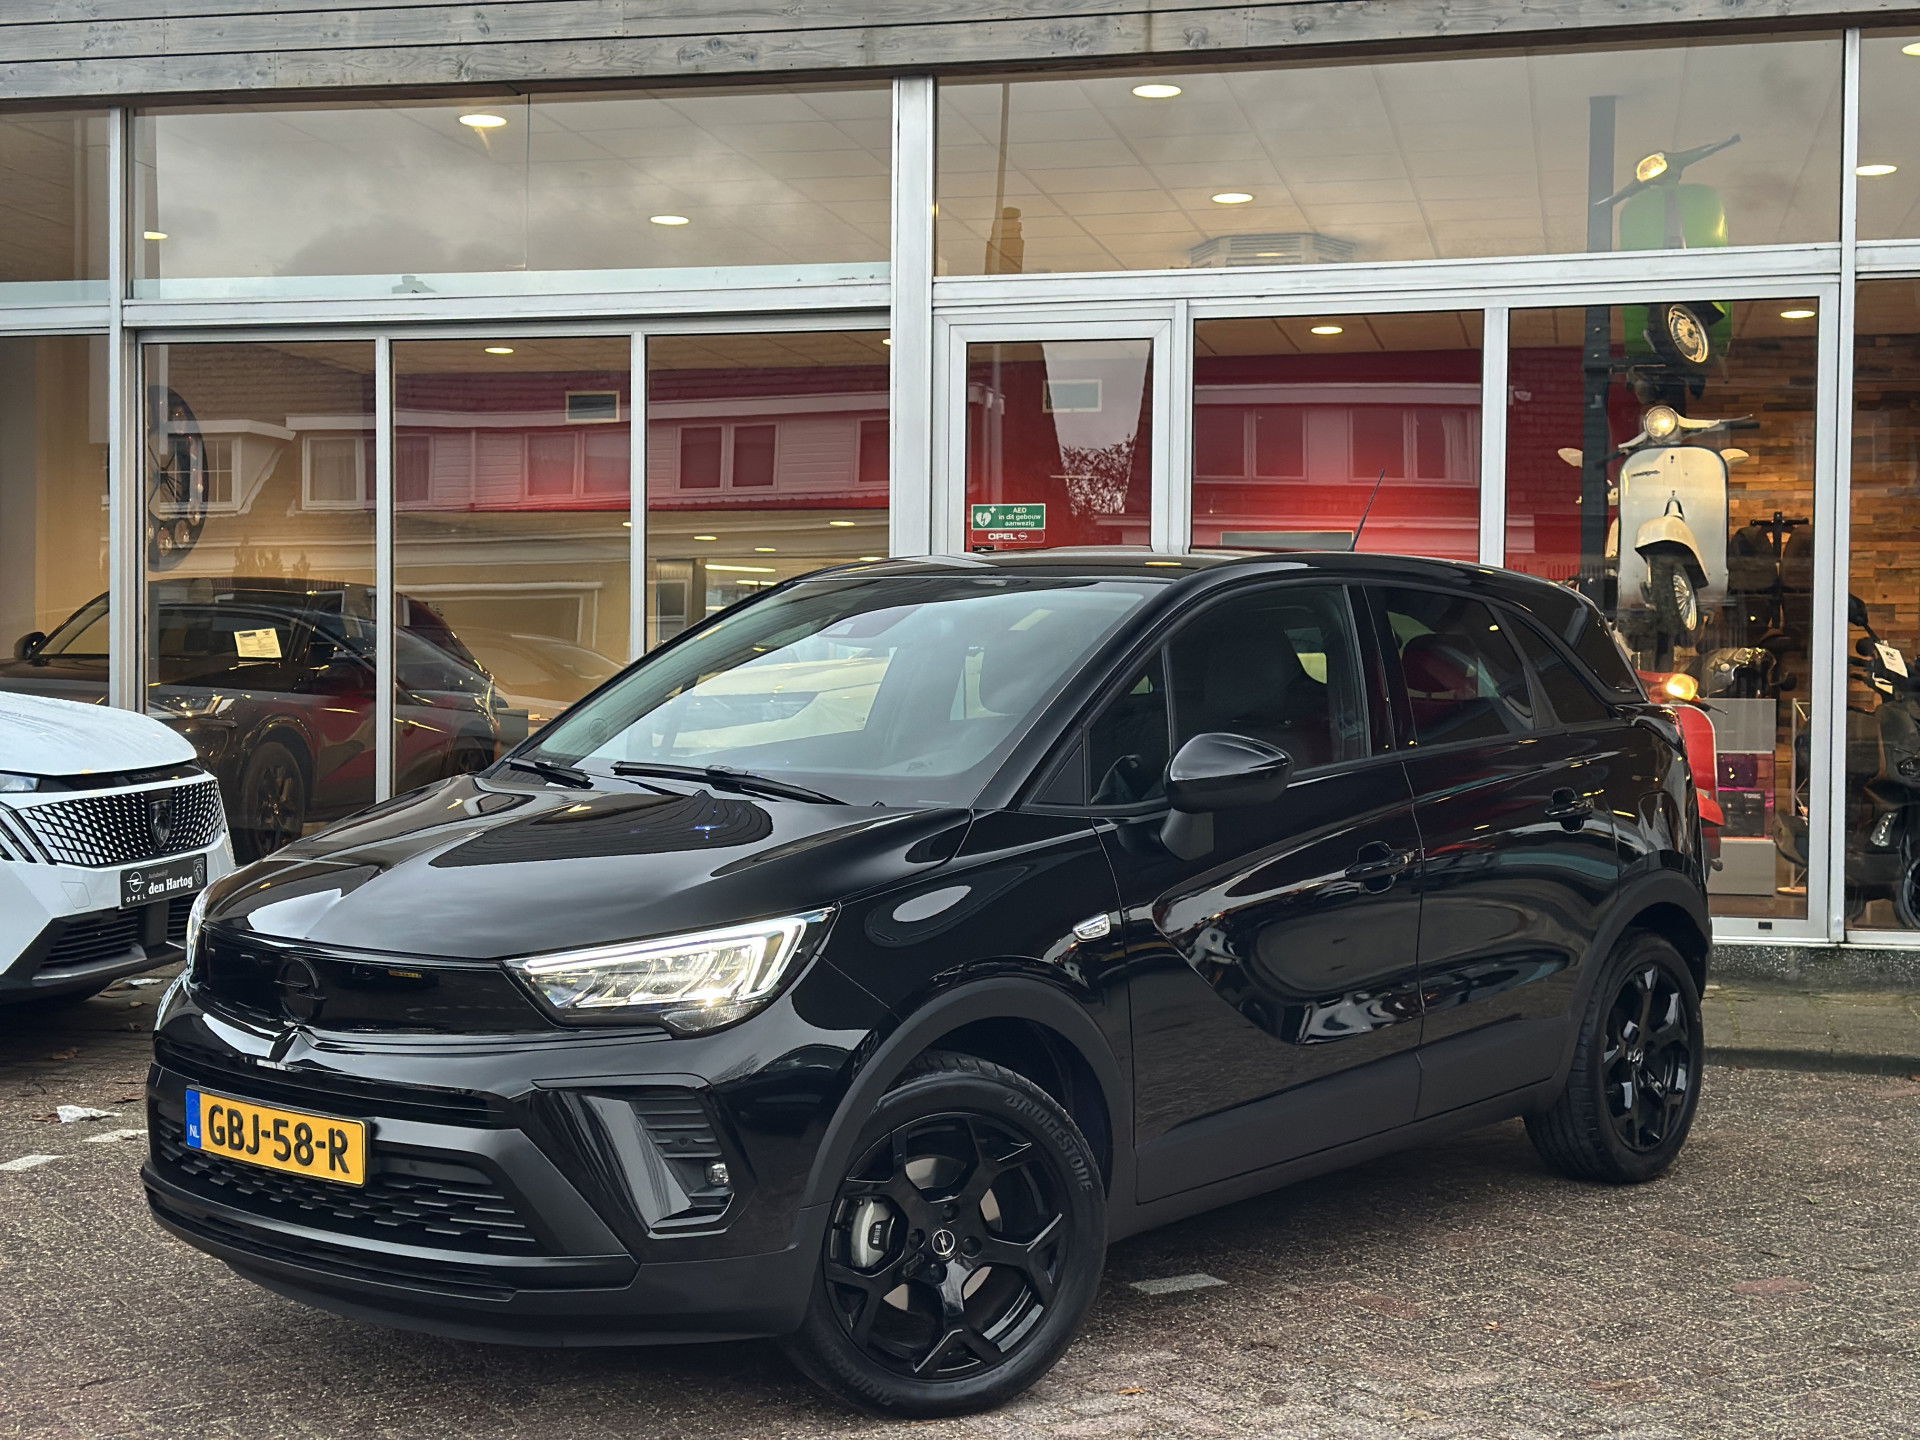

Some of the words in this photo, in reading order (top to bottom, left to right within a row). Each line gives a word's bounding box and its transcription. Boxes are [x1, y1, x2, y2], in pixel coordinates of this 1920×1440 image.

[148, 882, 165, 895] den
[166, 876, 193, 891] Hartog
[126, 894, 146, 903] OPEL
[189, 1124, 200, 1139] NL
[208, 1103, 350, 1174] GBJ-58-R
[1004, 1093, 1095, 1192] BRIDGESTONE
